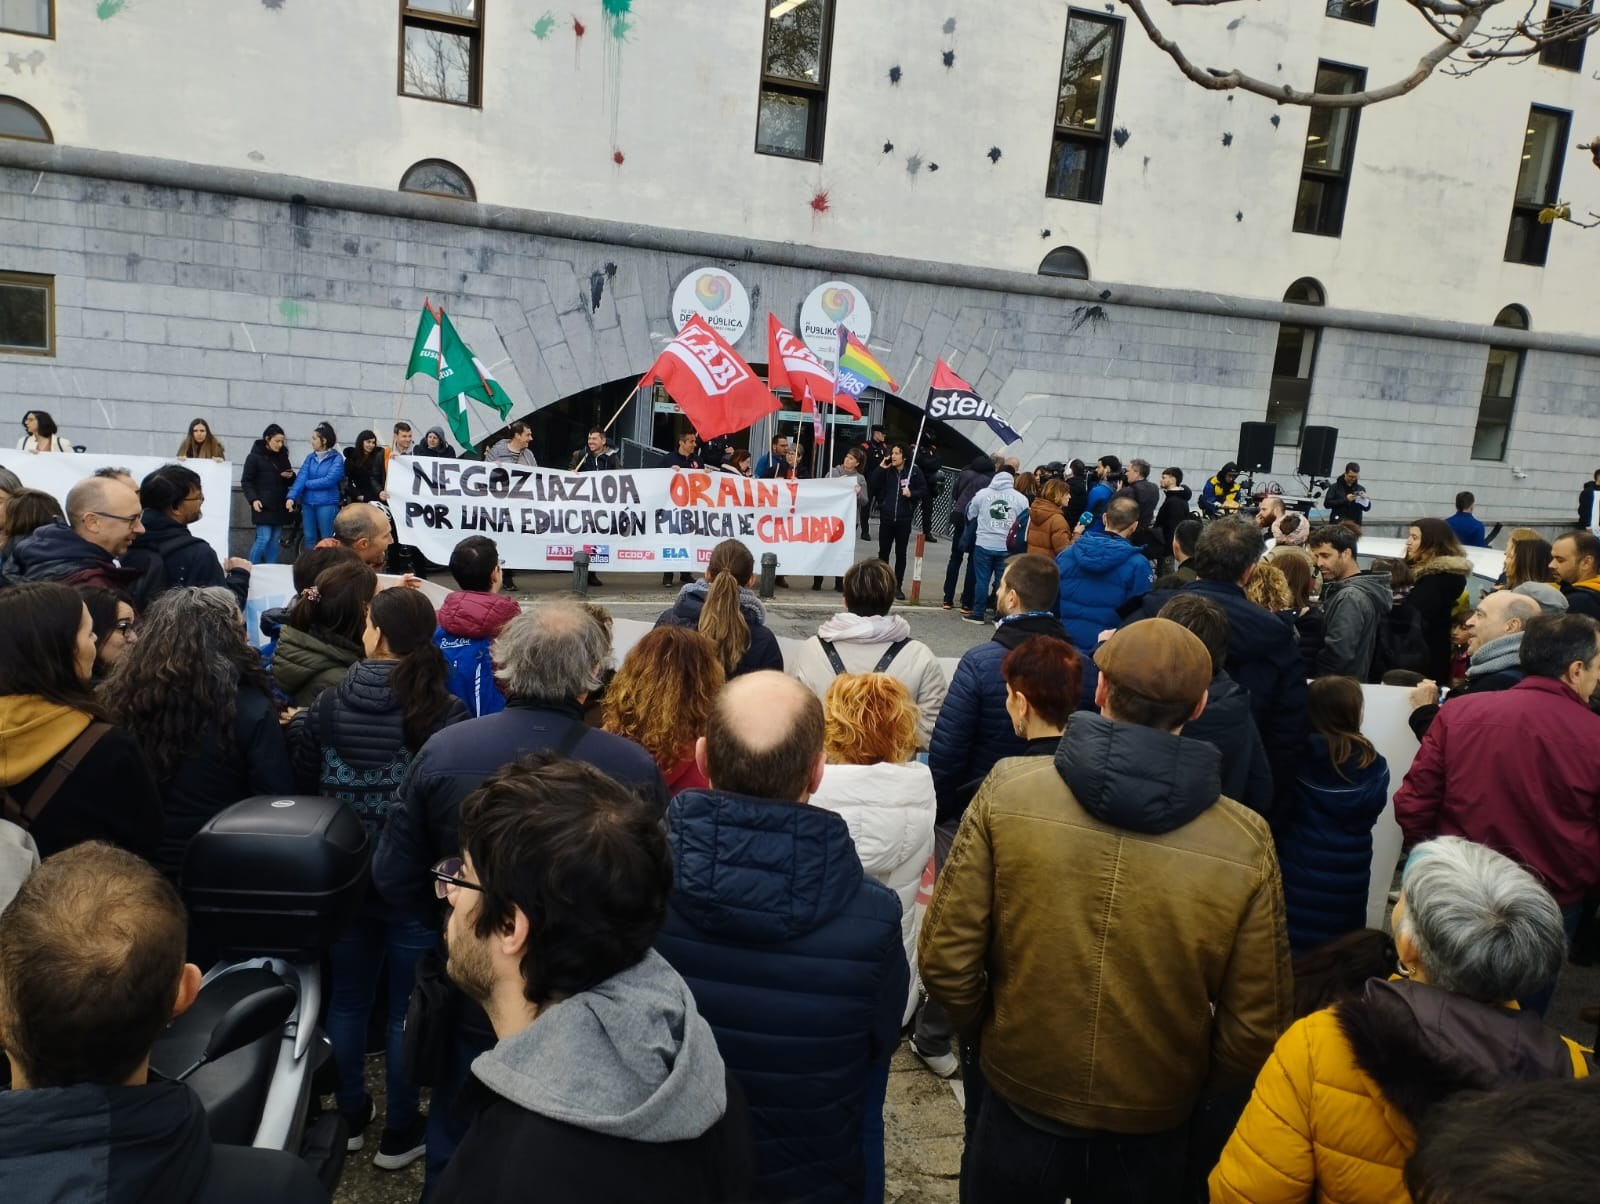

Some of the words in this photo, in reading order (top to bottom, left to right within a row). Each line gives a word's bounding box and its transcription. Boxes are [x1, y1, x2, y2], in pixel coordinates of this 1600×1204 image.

[680, 327, 736, 386] LAB
[412, 461, 640, 504] NEGOZIAZIOA
[405, 502, 453, 530] POR
[461, 505, 514, 533] UNA
[520, 507, 646, 537] EDUCACIÓN
[655, 508, 735, 537] PÚBLICA
[738, 512, 754, 536] DE
[757, 514, 845, 544] CALIDAD
[547, 545, 573, 555] LAB
[662, 547, 689, 559] ELA
[698, 551, 713, 561] UG
